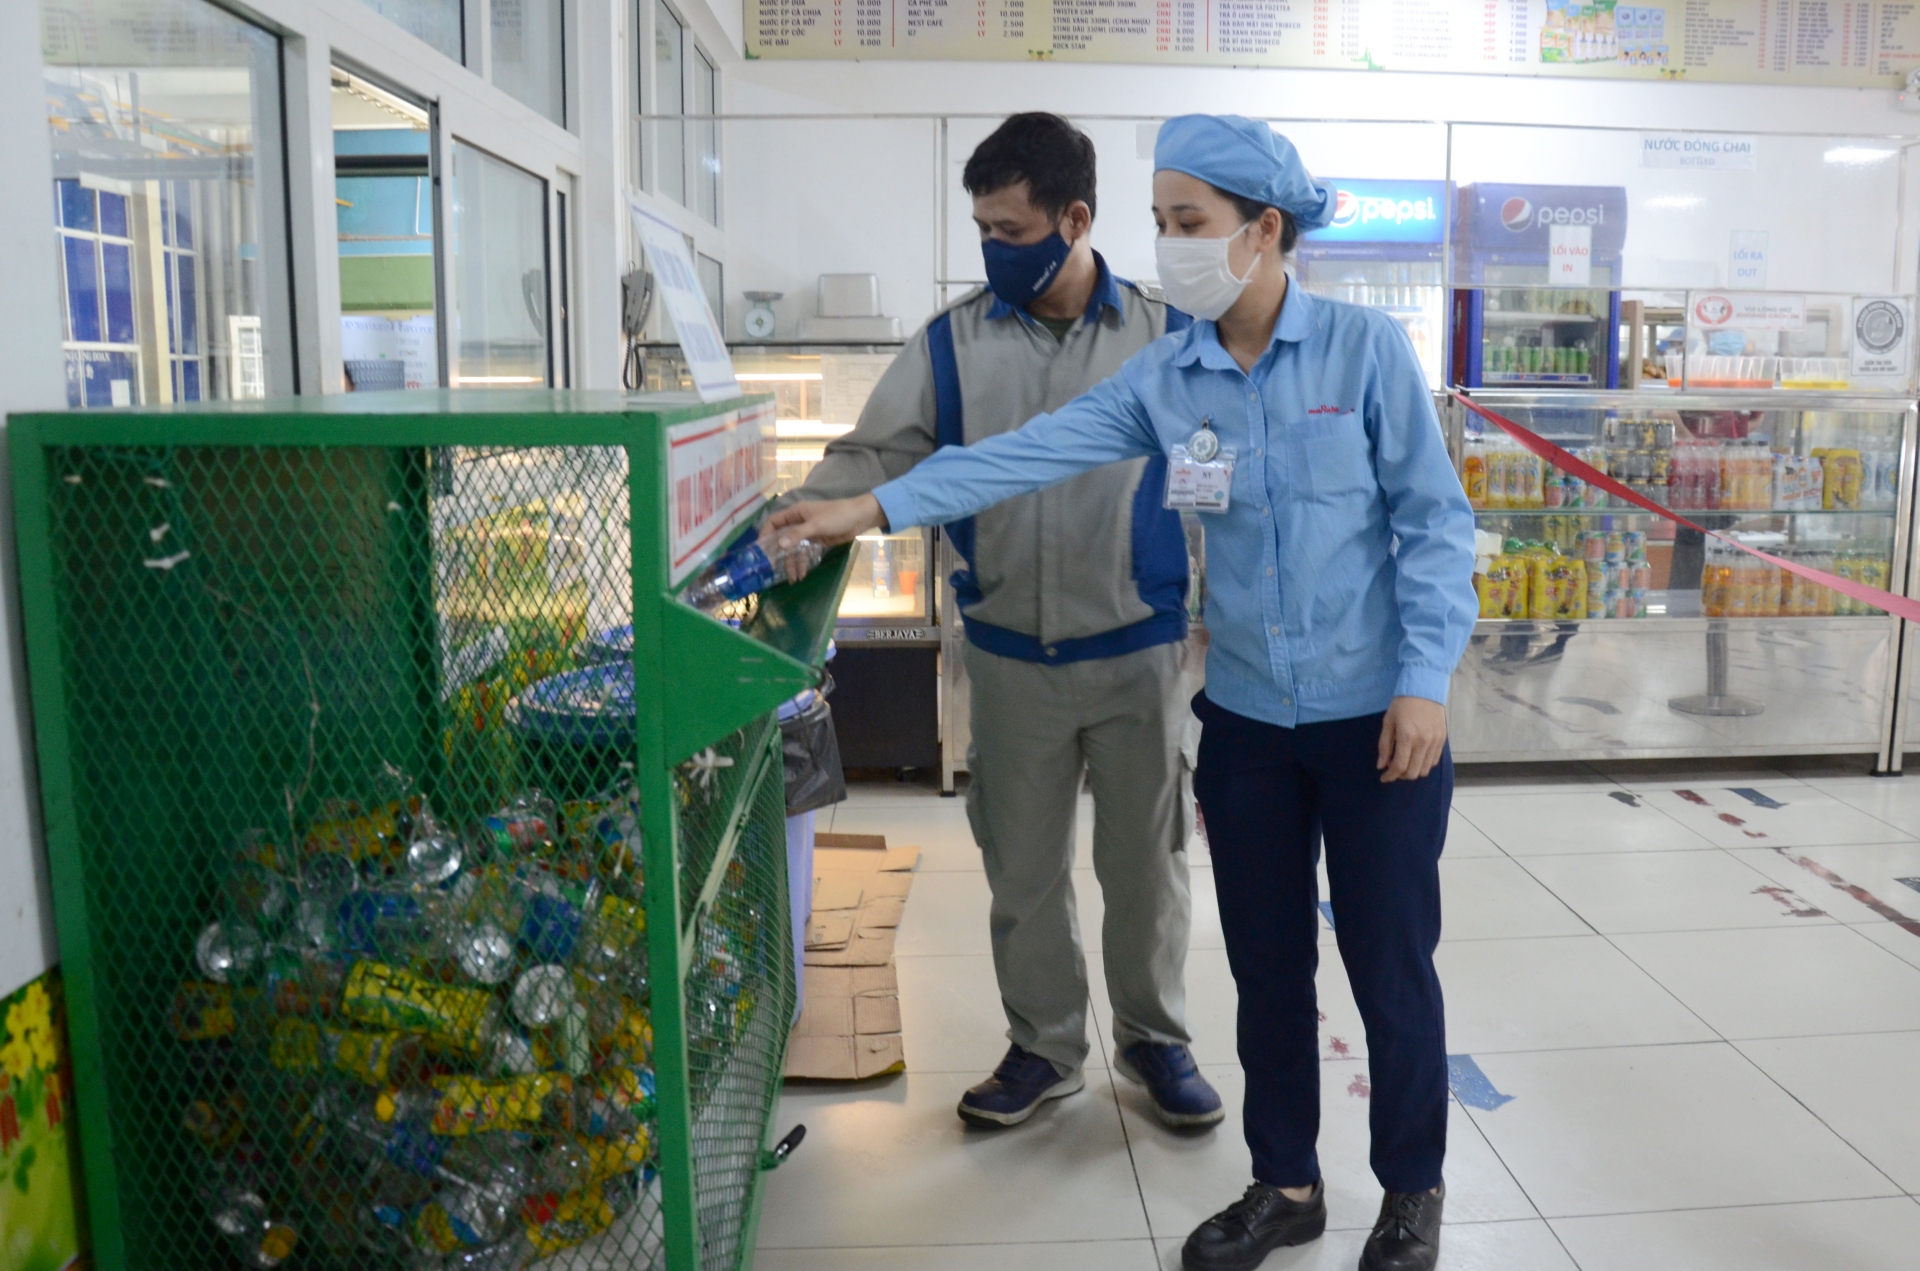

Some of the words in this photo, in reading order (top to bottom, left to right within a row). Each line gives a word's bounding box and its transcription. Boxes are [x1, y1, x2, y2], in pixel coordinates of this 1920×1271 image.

[1644, 138, 1680, 151] NƯỚC
[1684, 138, 1720, 152] ĐÓNG
[1724, 142, 1750, 153] CHAI
[1680, 157, 1714, 166] BOTTLED
[1362, 197, 1432, 224] pepsi
[1538, 204, 1604, 226] pepsi
[1552, 244, 1567, 256] LỐI
[1570, 245, 1588, 256] VÀO
[1734, 248, 1748, 260] LỐI
[1750, 251, 1763, 260] RA
[1563, 263, 1573, 272] IN
[1738, 268, 1757, 277] OUT
[875, 630, 916, 640] BERJAYA
